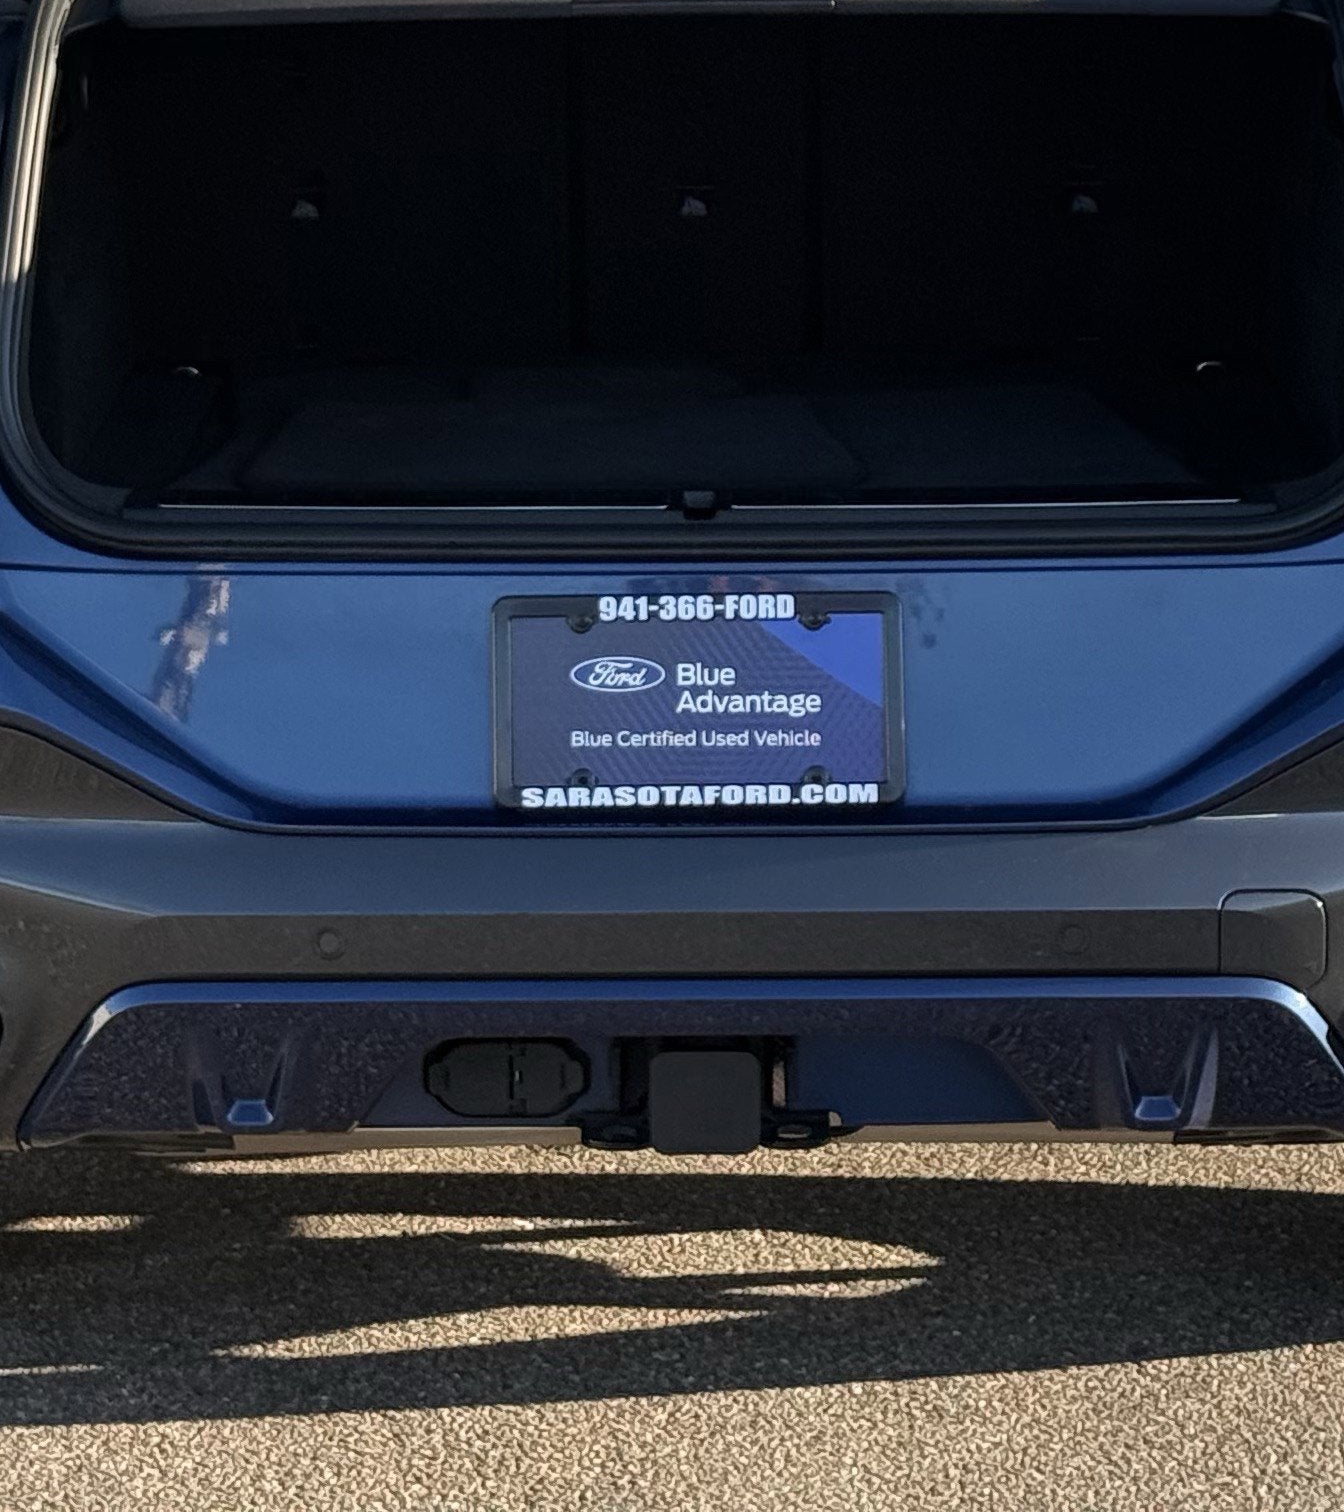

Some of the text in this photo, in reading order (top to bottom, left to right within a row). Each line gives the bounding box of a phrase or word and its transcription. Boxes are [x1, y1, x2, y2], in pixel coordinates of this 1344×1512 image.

[598, 594, 796, 622] 941-366-FORD
[587, 661, 647, 687] Ford
[676, 662, 736, 686] Blue
[675, 689, 823, 718] Advantage
[570, 730, 823, 748] Blue Certified Used Vehicle
[520, 782, 880, 809] SARASOTAFORD.COM
